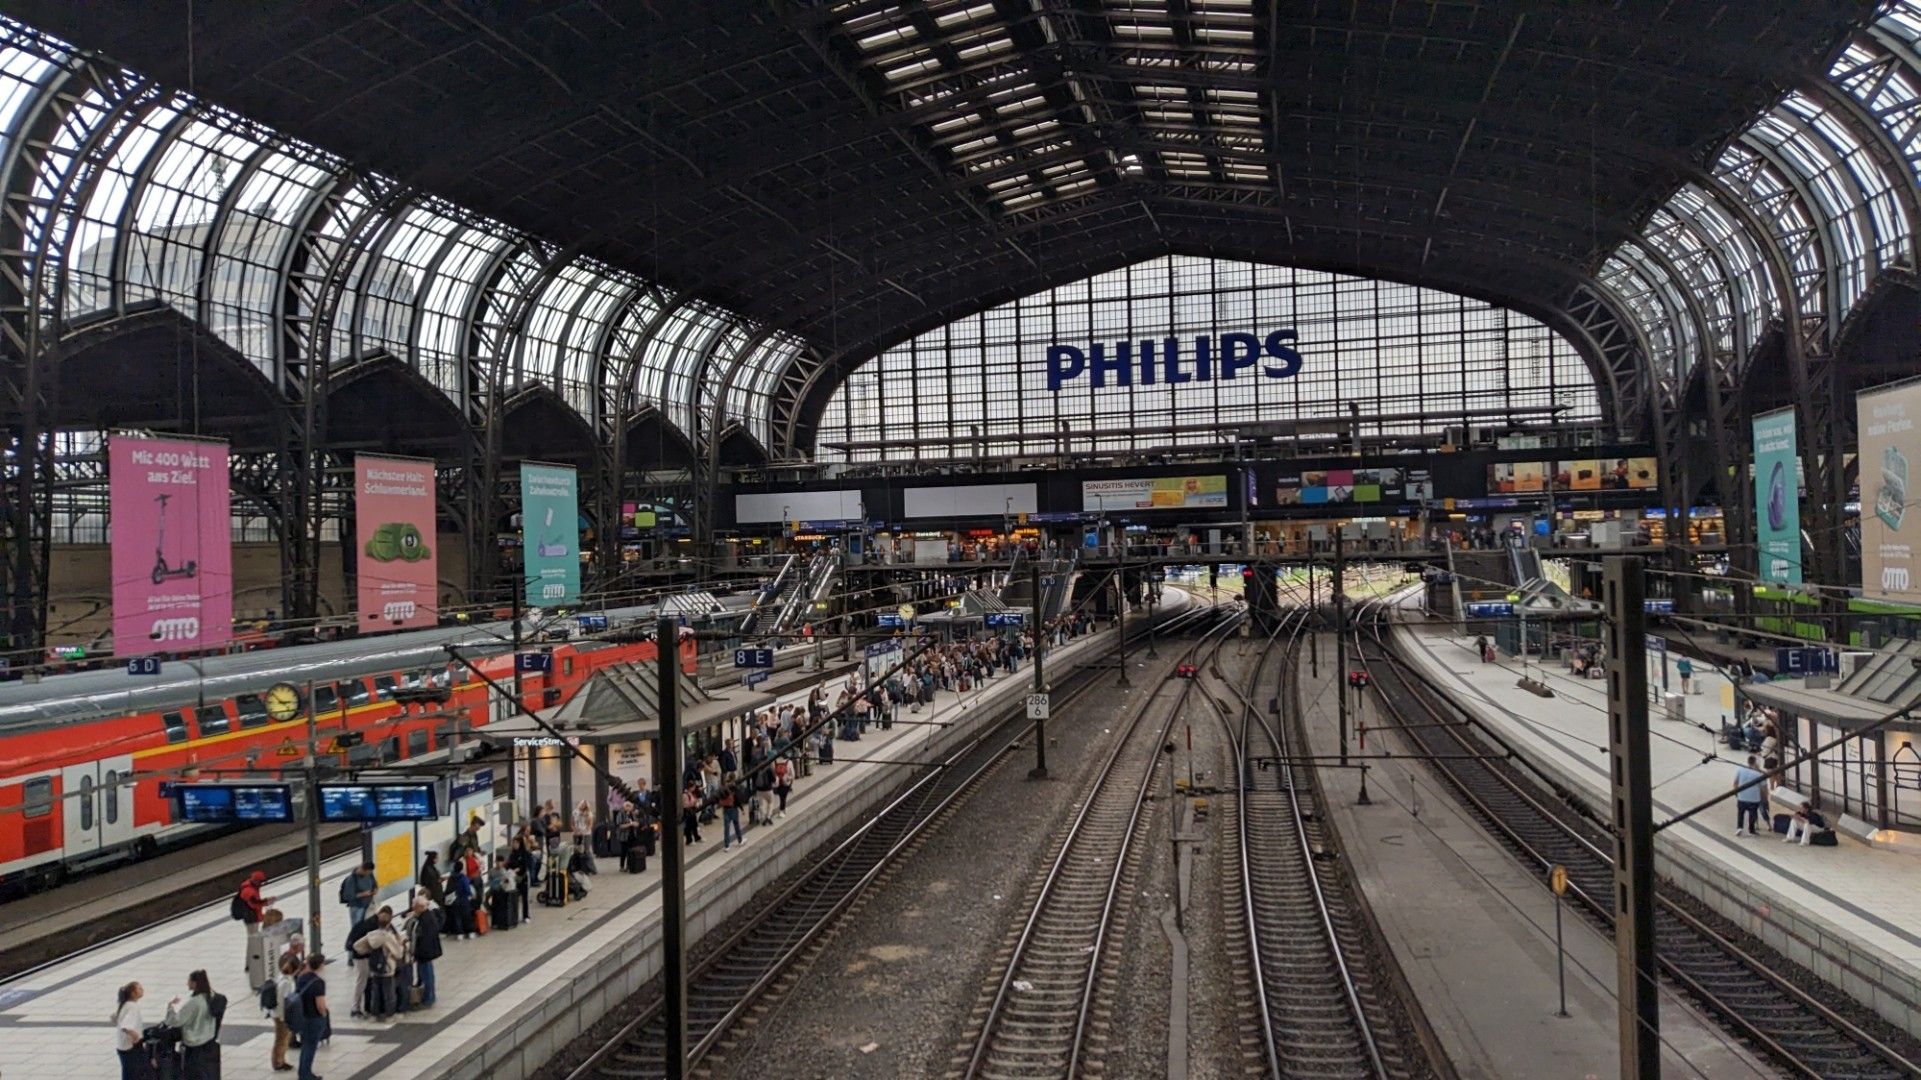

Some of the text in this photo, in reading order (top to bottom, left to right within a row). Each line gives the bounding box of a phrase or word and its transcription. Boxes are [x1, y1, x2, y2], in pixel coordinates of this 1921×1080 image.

[1047, 329, 1302, 391] PHILIPS
[132, 451, 210, 468] Mit 400 Watt
[1085, 480, 1155, 490] SINUSITIS HEVERT
[1881, 567, 1910, 590] OTTO
[384, 601, 415, 620] OTTO
[152, 617, 199, 641] OTTO
[523, 655, 550, 668] E 7
[737, 650, 765, 664] 8 E
[1789, 650, 1835, 667] E 11
[129, 659, 154, 672] 6 D
[1027, 695, 1047, 705] 286
[1035, 706, 1041, 716] 6
